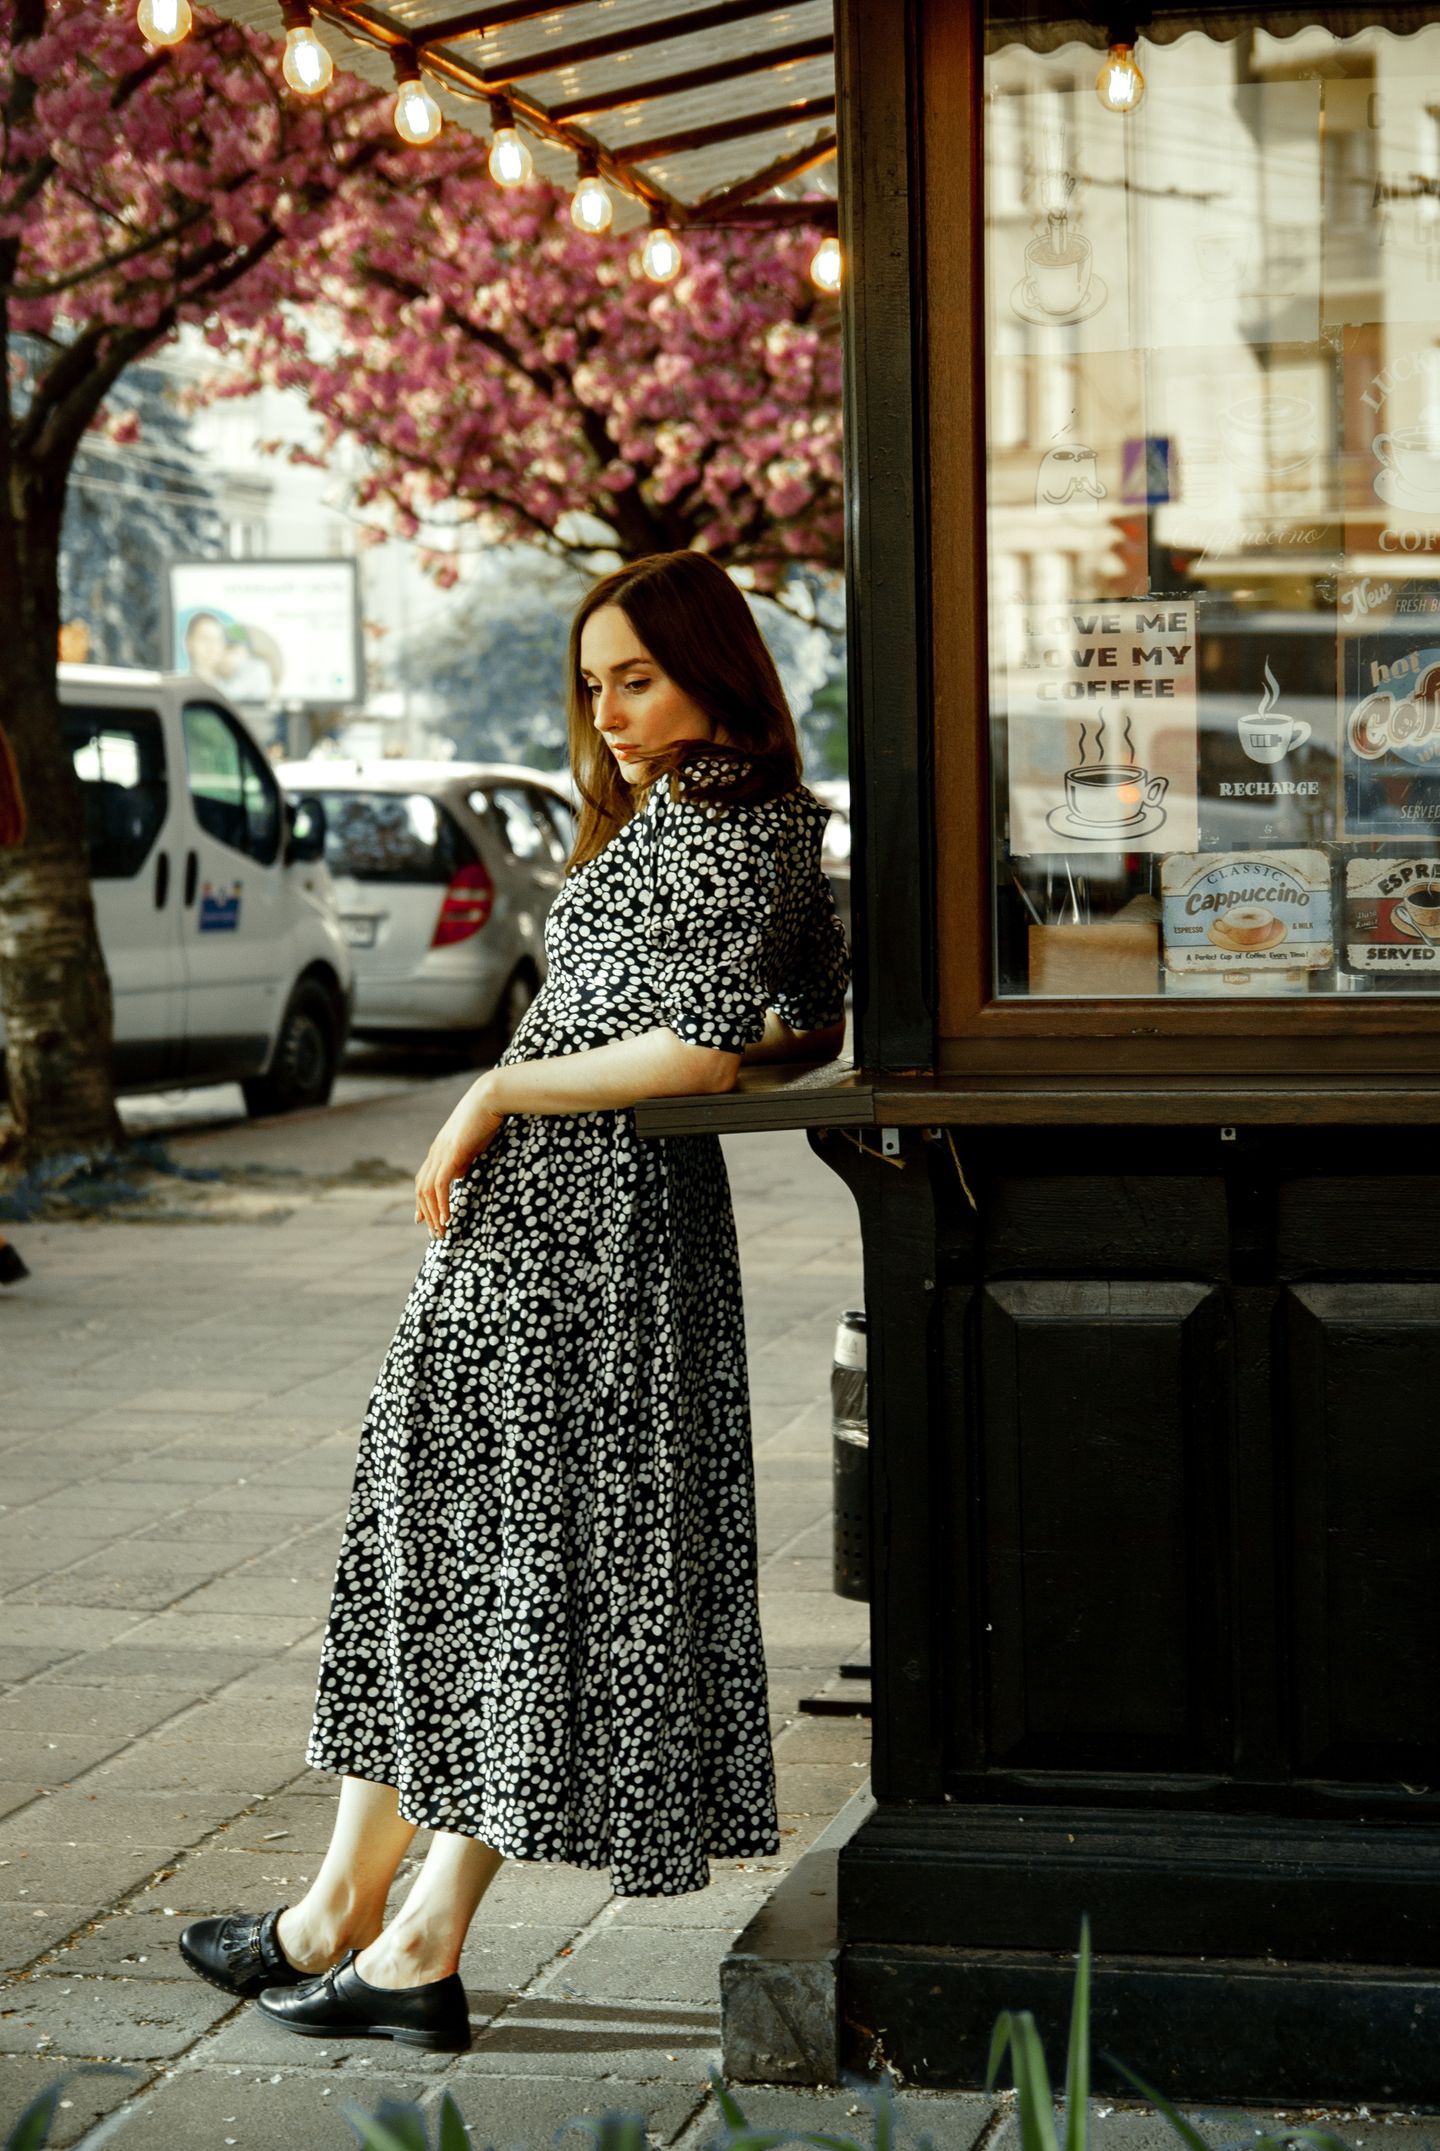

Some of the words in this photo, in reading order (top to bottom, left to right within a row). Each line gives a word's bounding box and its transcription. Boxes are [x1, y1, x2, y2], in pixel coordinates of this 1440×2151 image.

[1342, 577, 1392, 623] New
[1395, 599, 1427, 613] FRESH
[1136, 612, 1188, 633] ME
[1132, 645, 1192, 667] MY
[1370, 651, 1420, 688] hot
[1036, 678, 1175, 701] COFFEE
[1219, 781, 1319, 796] RECHARGE
[1206, 864, 1283, 885] CLASSIC
[1185, 882, 1310, 916] Cappuccino
[1173, 926, 1203, 934] ESPRESSO
[1195, 953, 1217, 961] Perfect
[1245, 952, 1266, 960] Coffee
[1269, 951, 1288, 960] Every
[1366, 948, 1436, 961] SERVED
[1224, 974, 1250, 983] Lipton
